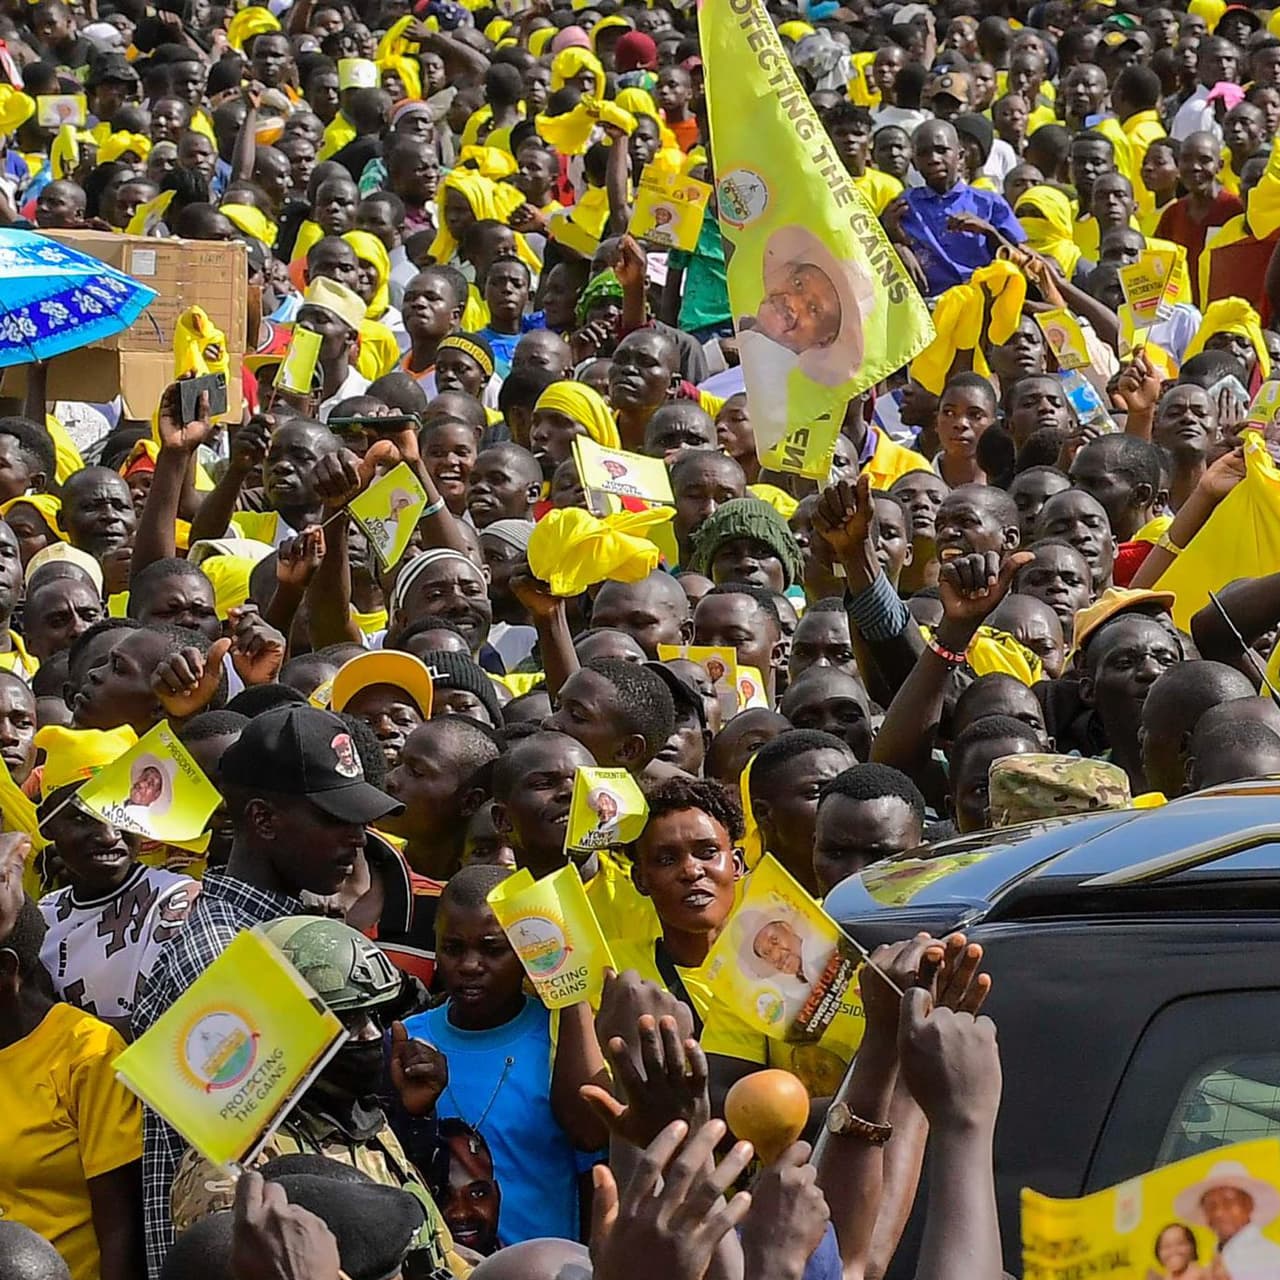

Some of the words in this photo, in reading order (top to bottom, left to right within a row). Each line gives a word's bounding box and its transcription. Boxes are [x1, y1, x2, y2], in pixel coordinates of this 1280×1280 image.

[811, 145, 853, 210] THE
[850, 213, 909, 305] GAINS
[166, 742, 198, 779] PRESIDENT
[550, 979, 588, 1001] GAINS
[806, 990, 837, 1034] YOWERI
[220, 1047, 285, 1121] PROTECTING
[235, 1097, 261, 1124] THE
[256, 1063, 288, 1100] GAINS
